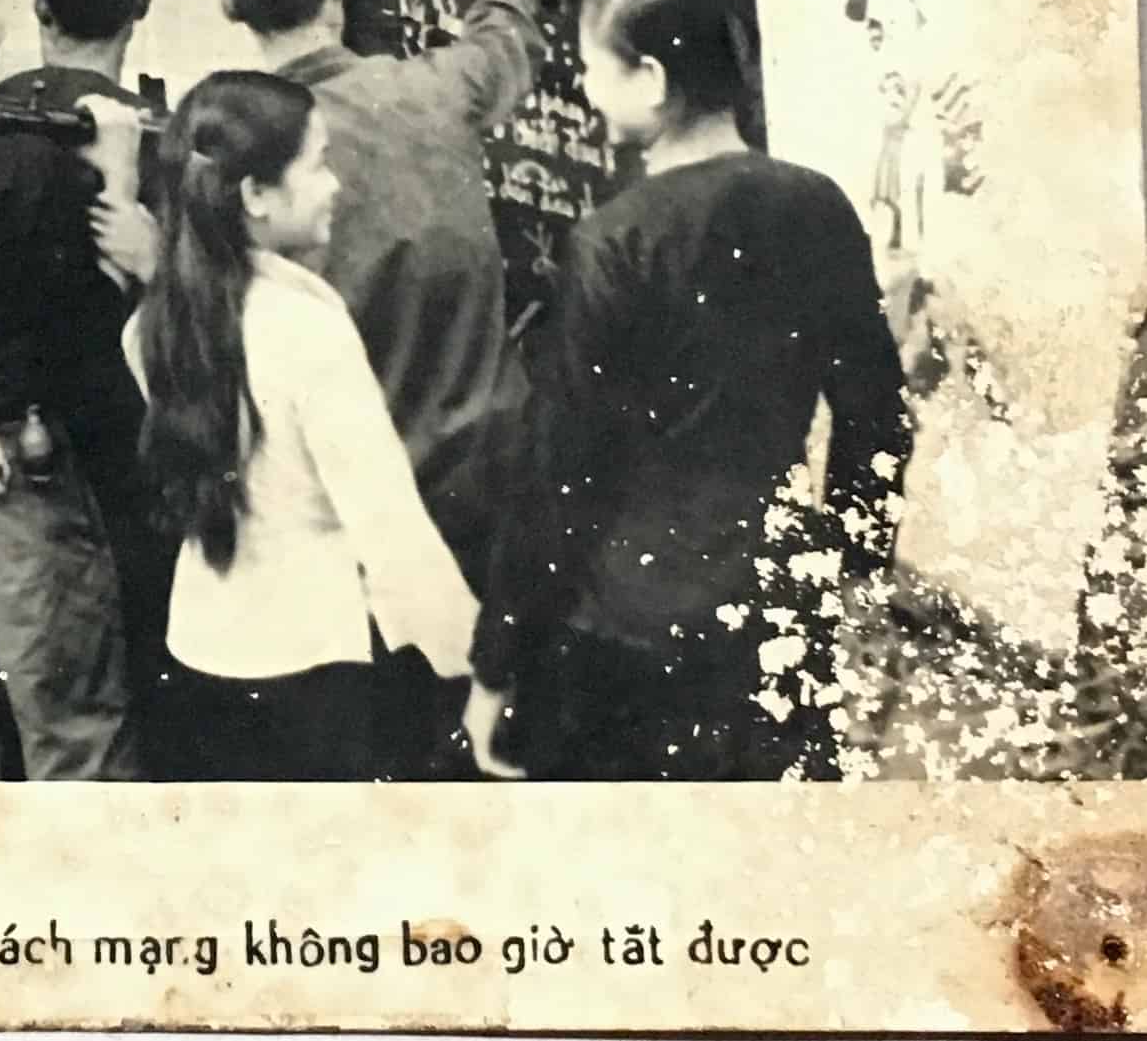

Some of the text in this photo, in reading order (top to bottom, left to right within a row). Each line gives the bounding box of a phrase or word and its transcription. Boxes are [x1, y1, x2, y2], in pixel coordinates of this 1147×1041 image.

[244, 920, 380, 973] không
[402, 920, 483, 966] bao
[501, 924, 576, 975] giờ
[688, 919, 811, 973] được
